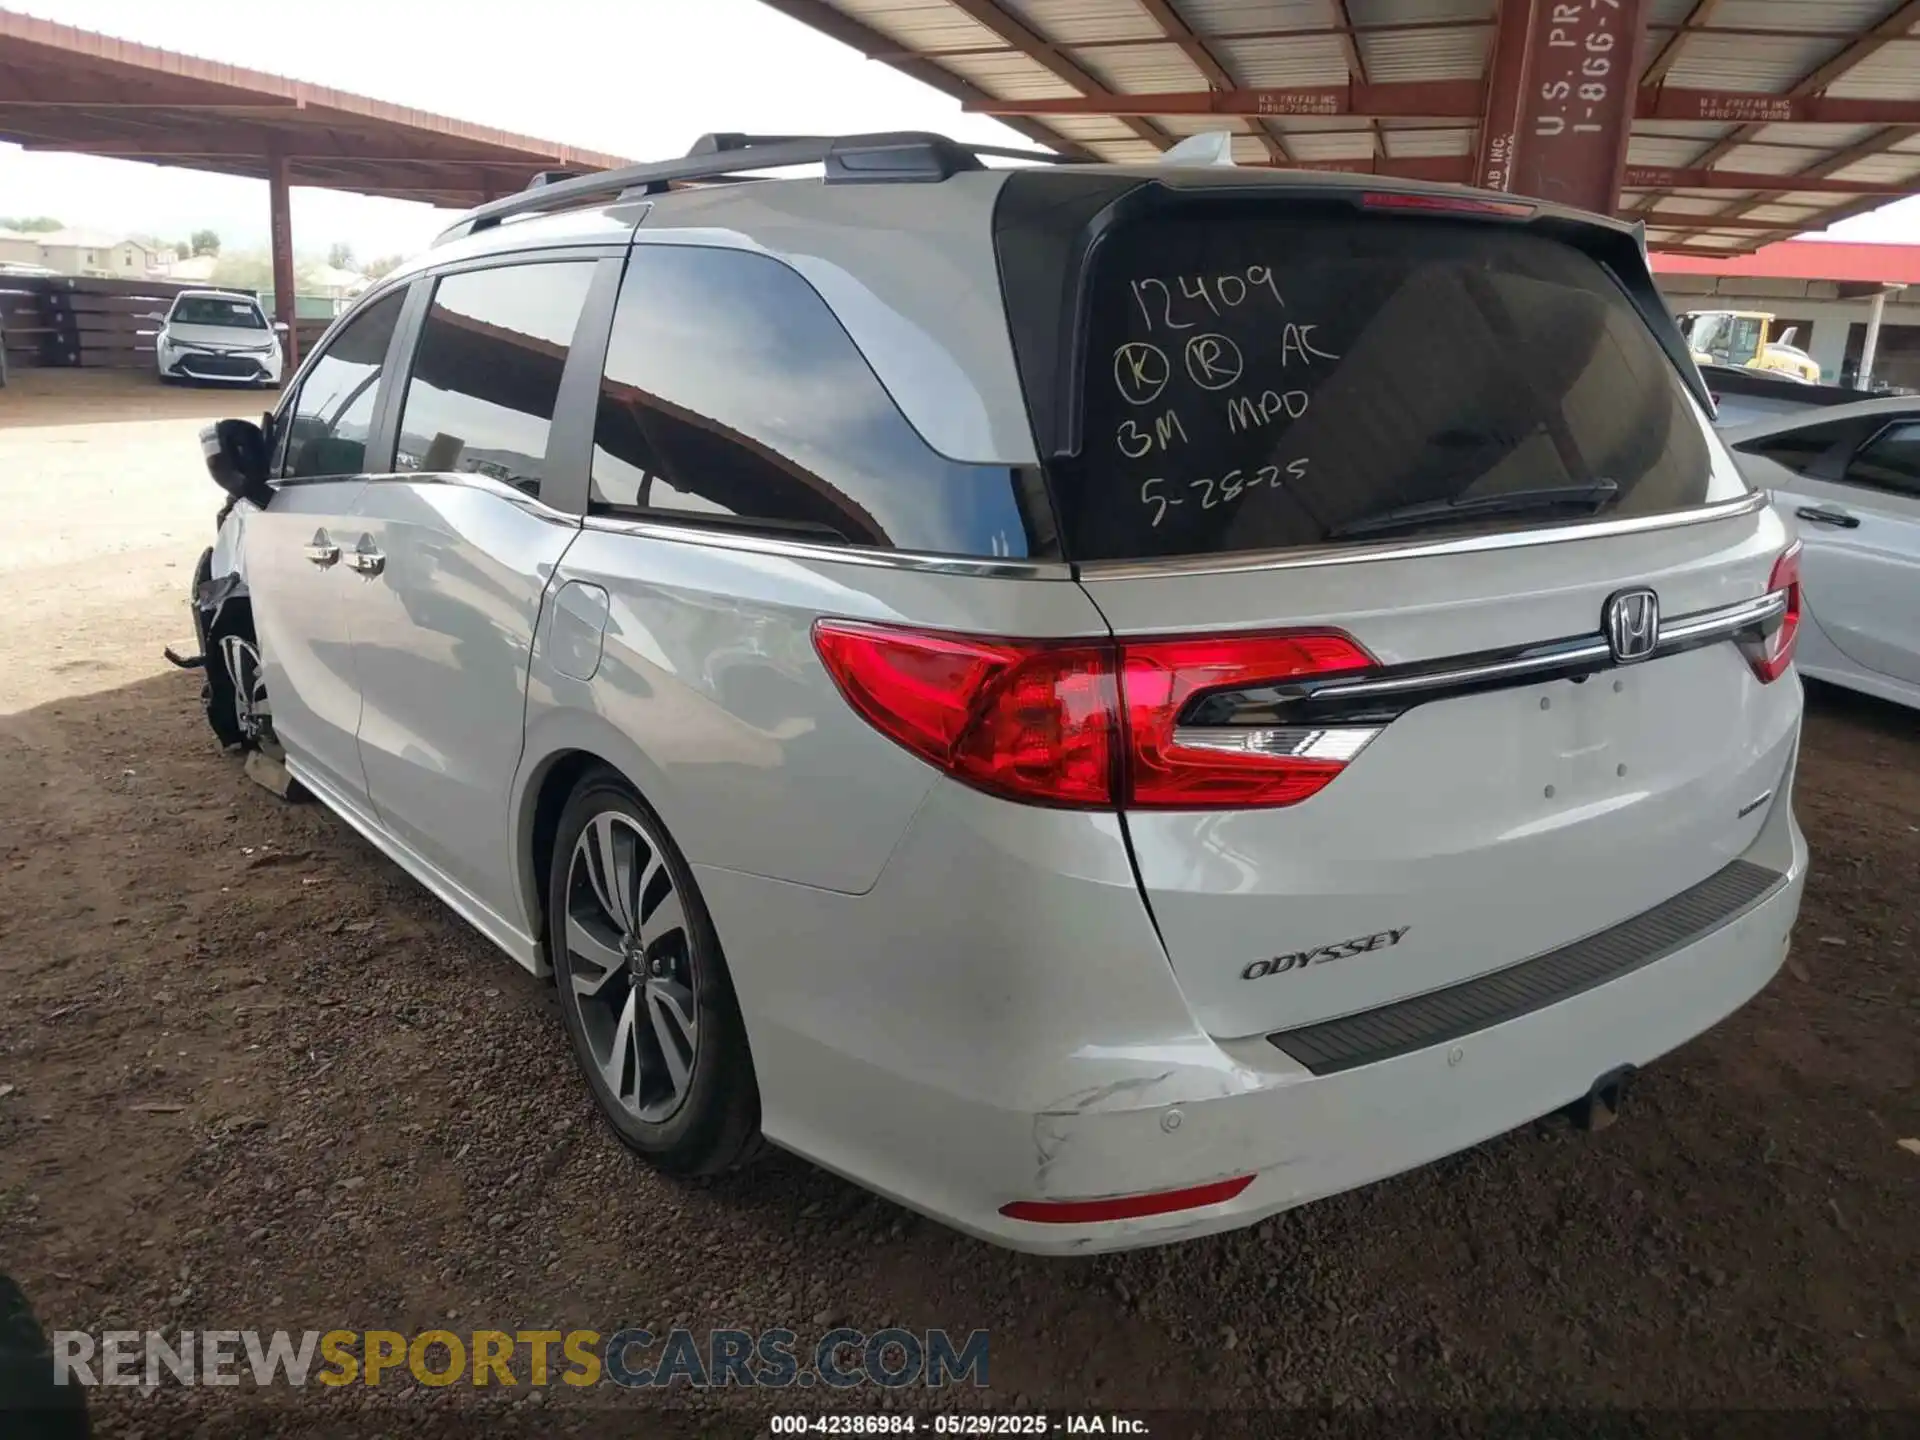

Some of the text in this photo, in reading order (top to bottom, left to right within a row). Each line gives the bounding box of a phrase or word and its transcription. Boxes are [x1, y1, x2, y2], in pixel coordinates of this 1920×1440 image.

[1535, 70, 1574, 136] U.S.
[1131, 265, 1285, 331] 12409
[1141, 458, 1309, 527] 5-28-25
[1240, 925, 1412, 981] ODYSSEY
